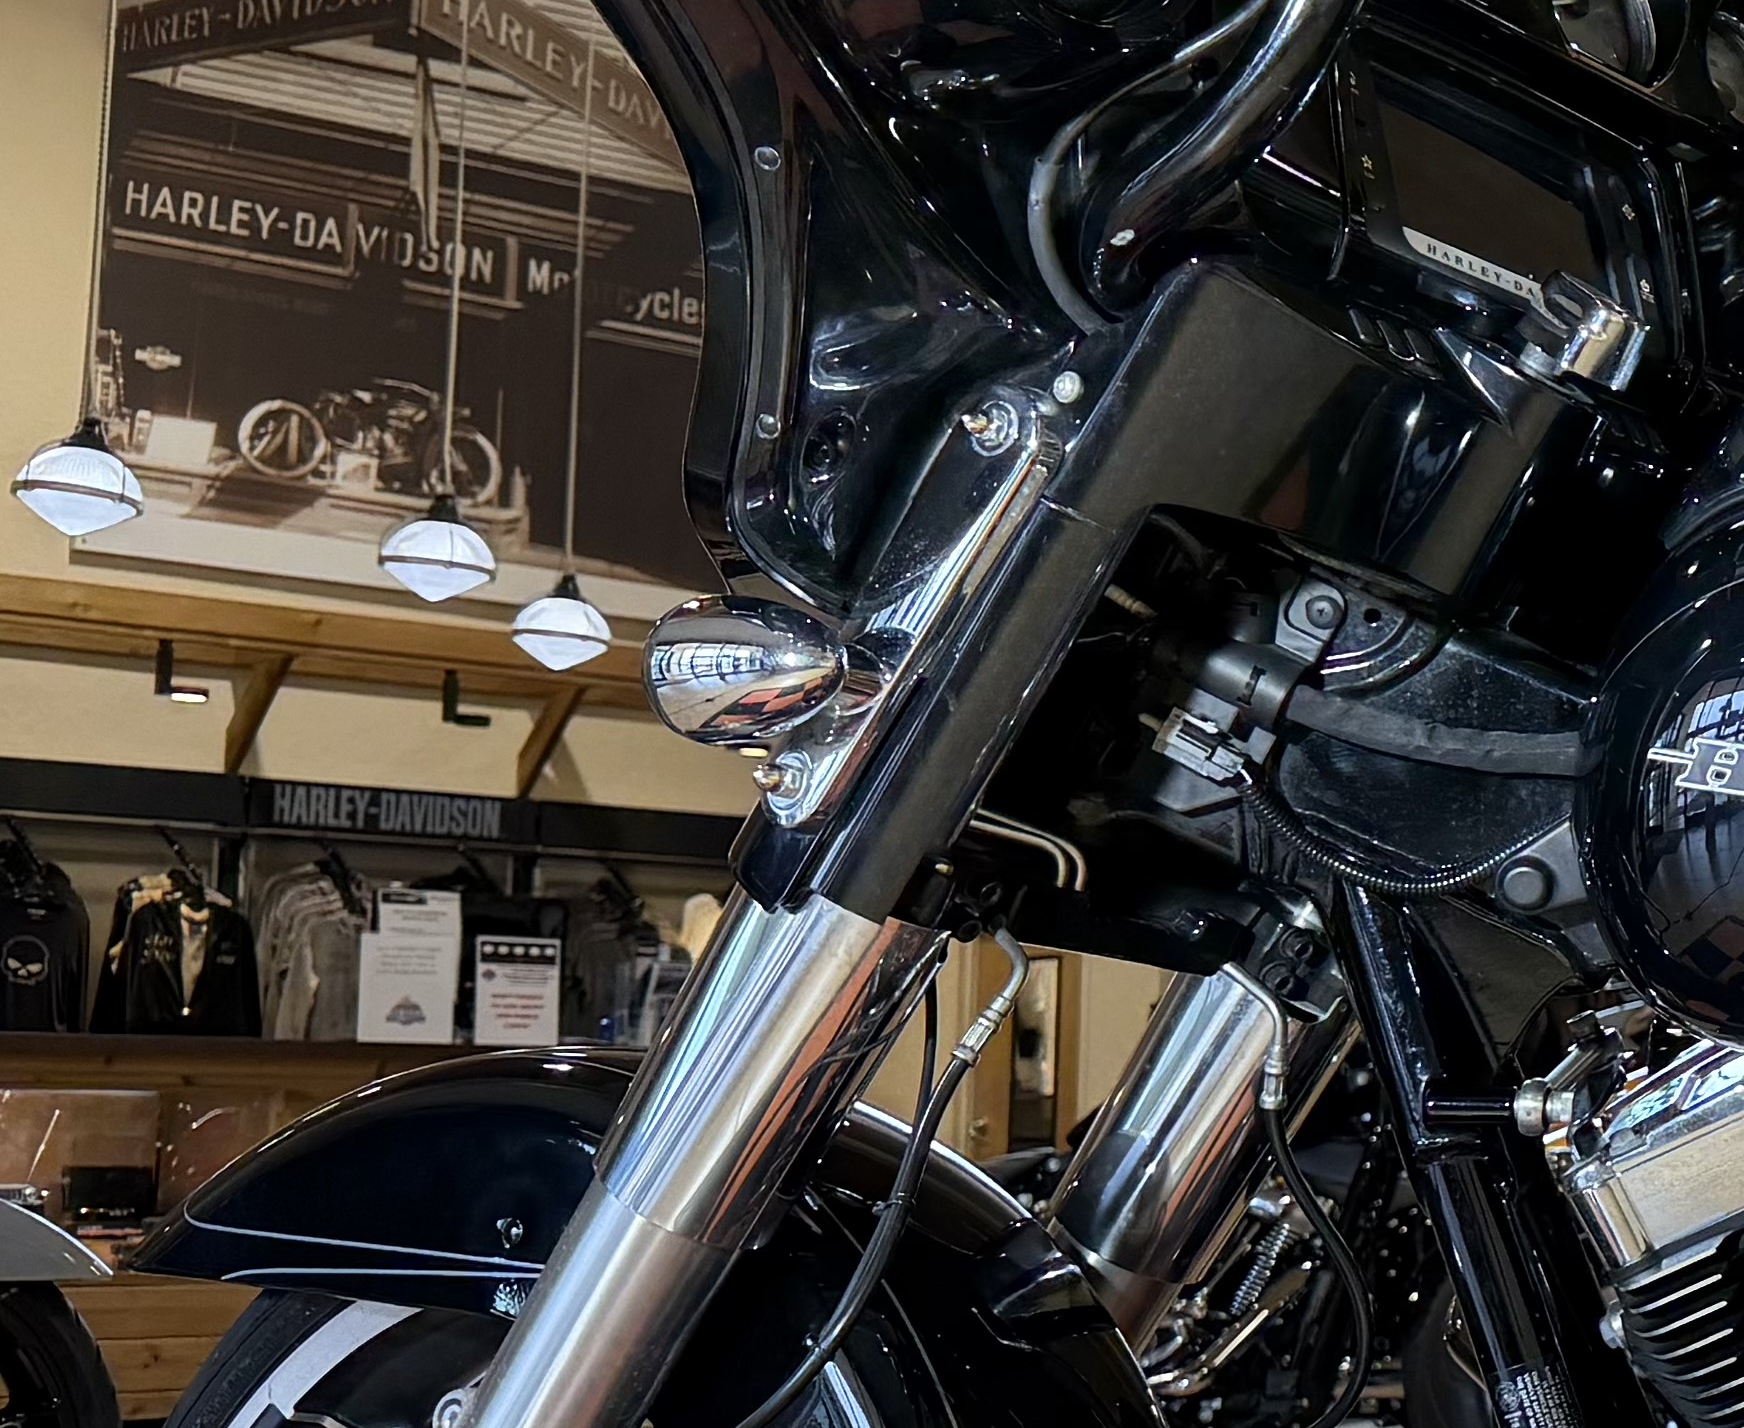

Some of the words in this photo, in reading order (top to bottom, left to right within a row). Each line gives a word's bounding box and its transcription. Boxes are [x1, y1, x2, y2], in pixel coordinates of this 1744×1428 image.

[125, 180, 496, 285] HARLEY-DAVIDSON
[1426, 242, 1541, 297] HARLEY-DA
[273, 784, 502, 838] HARLEY-DAVIDSON
